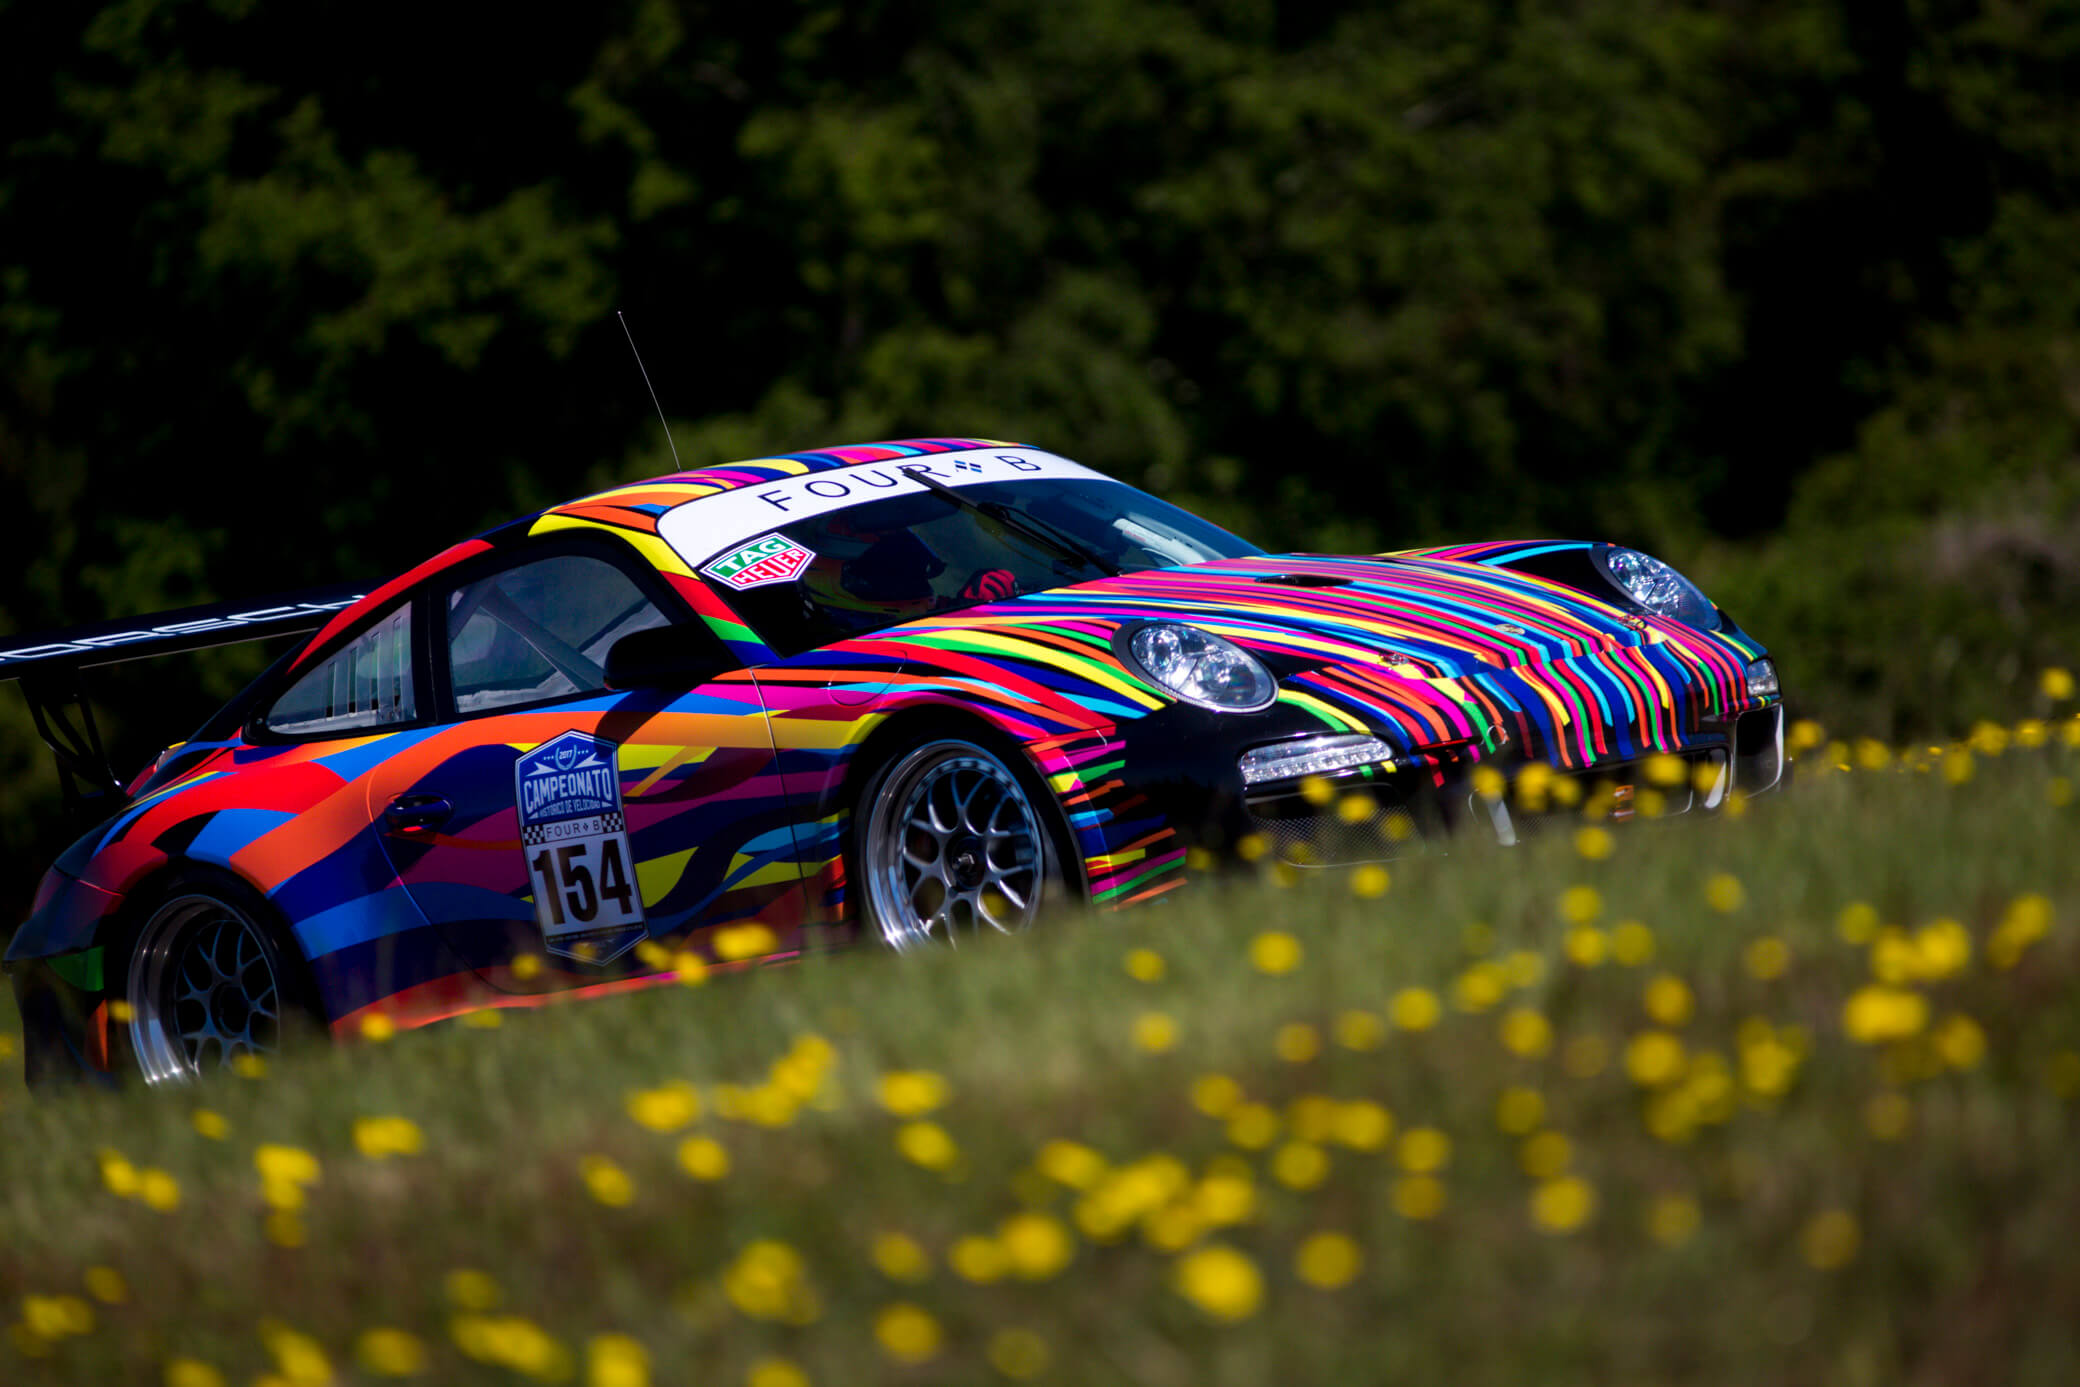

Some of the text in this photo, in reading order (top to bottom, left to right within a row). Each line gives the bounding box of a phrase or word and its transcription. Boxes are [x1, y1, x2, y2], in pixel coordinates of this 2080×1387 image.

[758, 455, 1042, 511] FOUR B
[716, 539, 787, 571] TAG
[732, 549, 804, 584] HEUER
[0, 594, 366, 663] ORSCH
[558, 749, 574, 760] 2017
[523, 768, 613, 814] CAMPEONATO
[565, 799, 573, 814] DE
[573, 799, 601, 812] VELOCIDAD
[546, 820, 600, 838] FOUR B
[532, 839, 633, 925] 154
